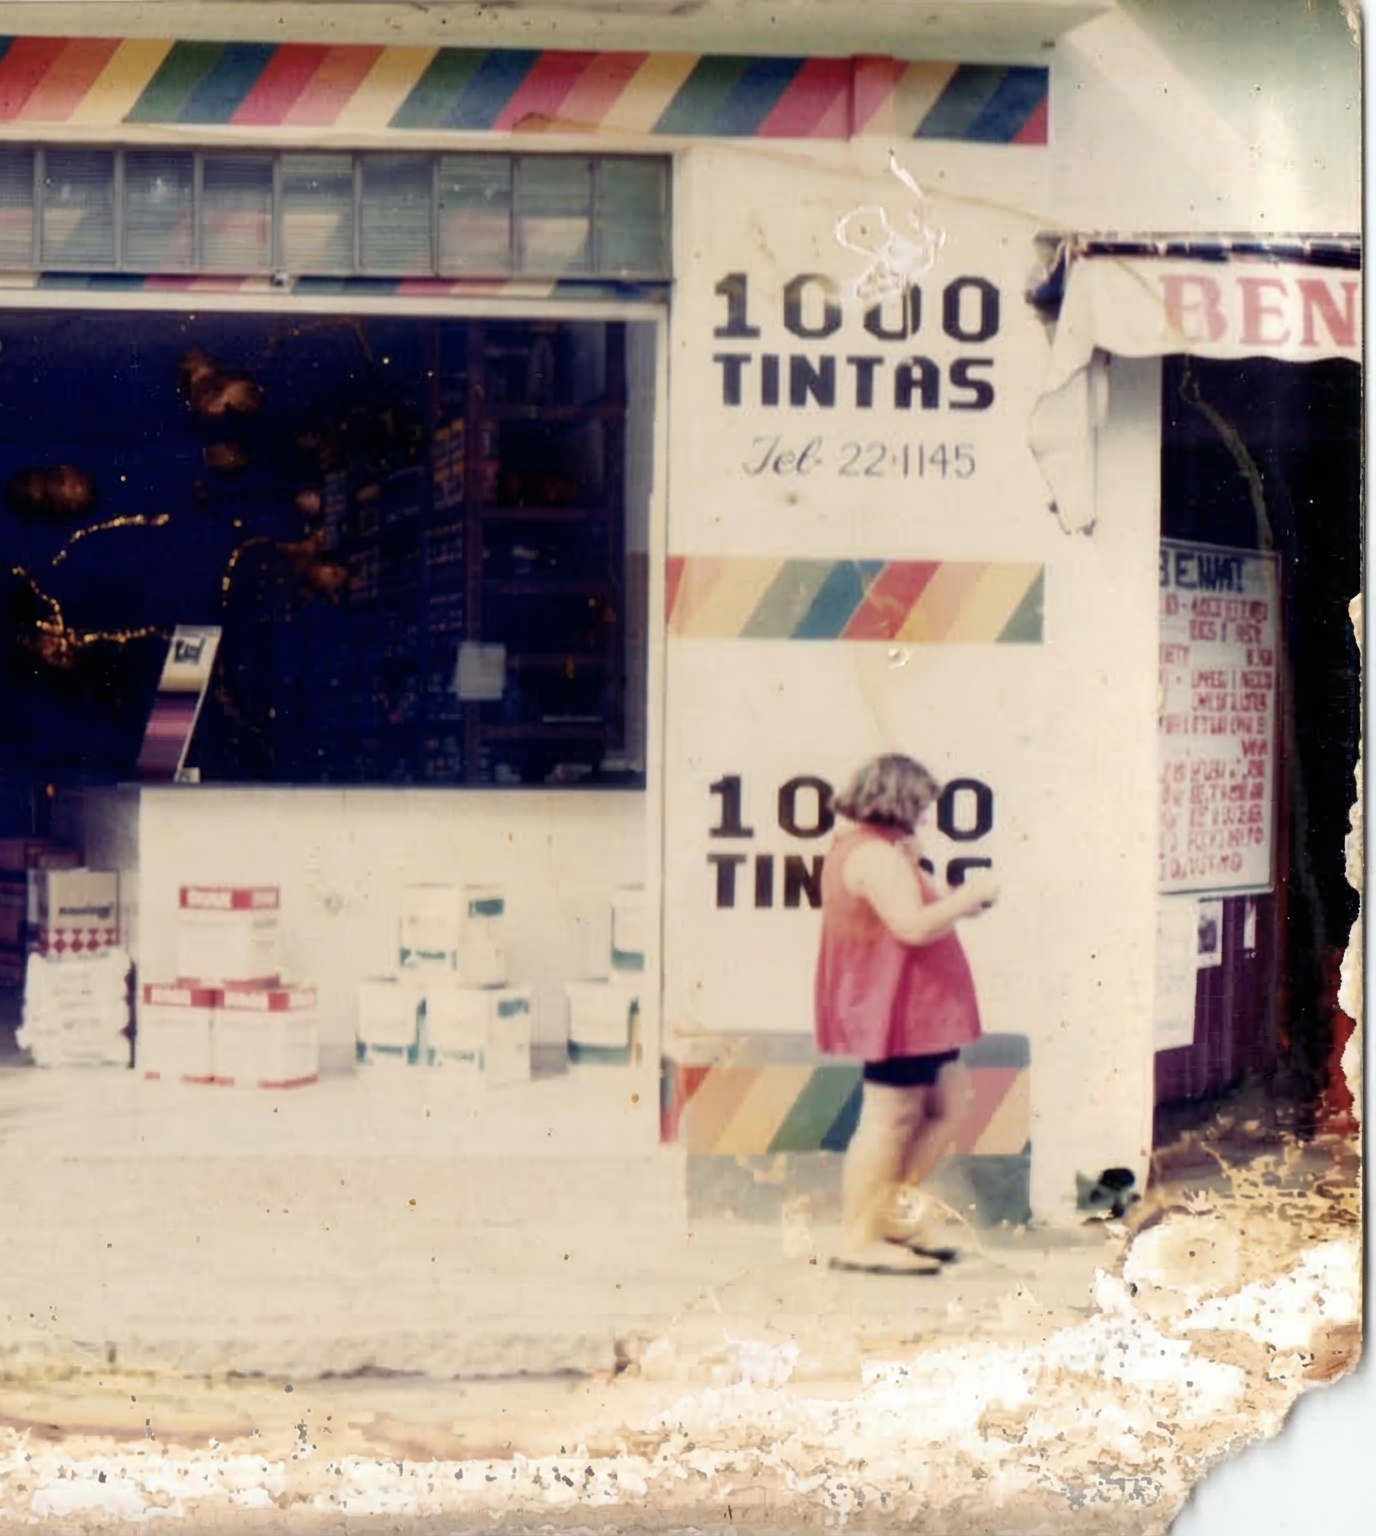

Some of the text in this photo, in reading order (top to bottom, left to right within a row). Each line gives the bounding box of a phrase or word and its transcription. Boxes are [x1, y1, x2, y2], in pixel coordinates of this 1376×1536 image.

[713, 272, 1000, 342] 1000
[1159, 275, 1359, 348] BEN
[713, 354, 995, 410] TINTAS
[709, 775, 994, 842] 100
